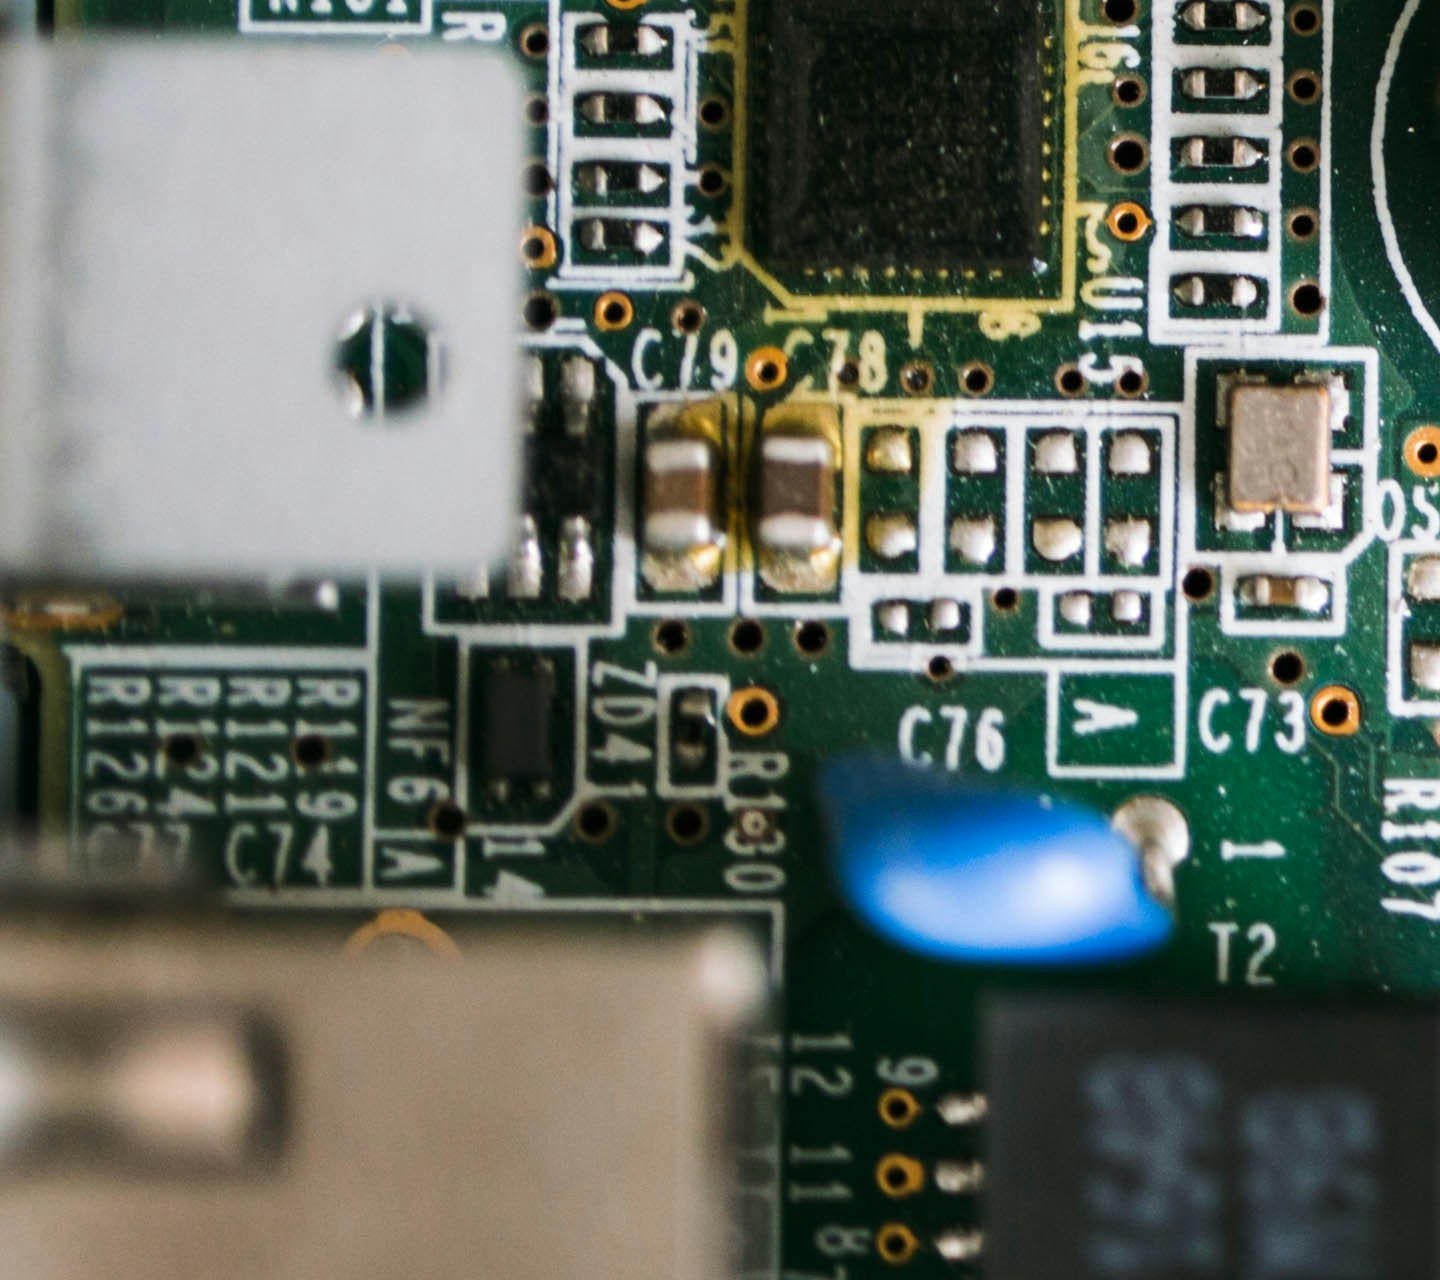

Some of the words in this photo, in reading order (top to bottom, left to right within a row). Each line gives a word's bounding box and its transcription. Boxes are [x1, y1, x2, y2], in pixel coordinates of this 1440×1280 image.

[1080, 277, 1144, 383] U15
[86, 676, 149, 814] R126
[224, 676, 289, 815] R121
[388, 697, 449, 803] NF6
[593, 659, 658, 797] ZD41
[900, 708, 1005, 769] C76
[1201, 689, 1305, 752] C73
[225, 824, 332, 886] C74
[1209, 922, 1276, 984] T2
